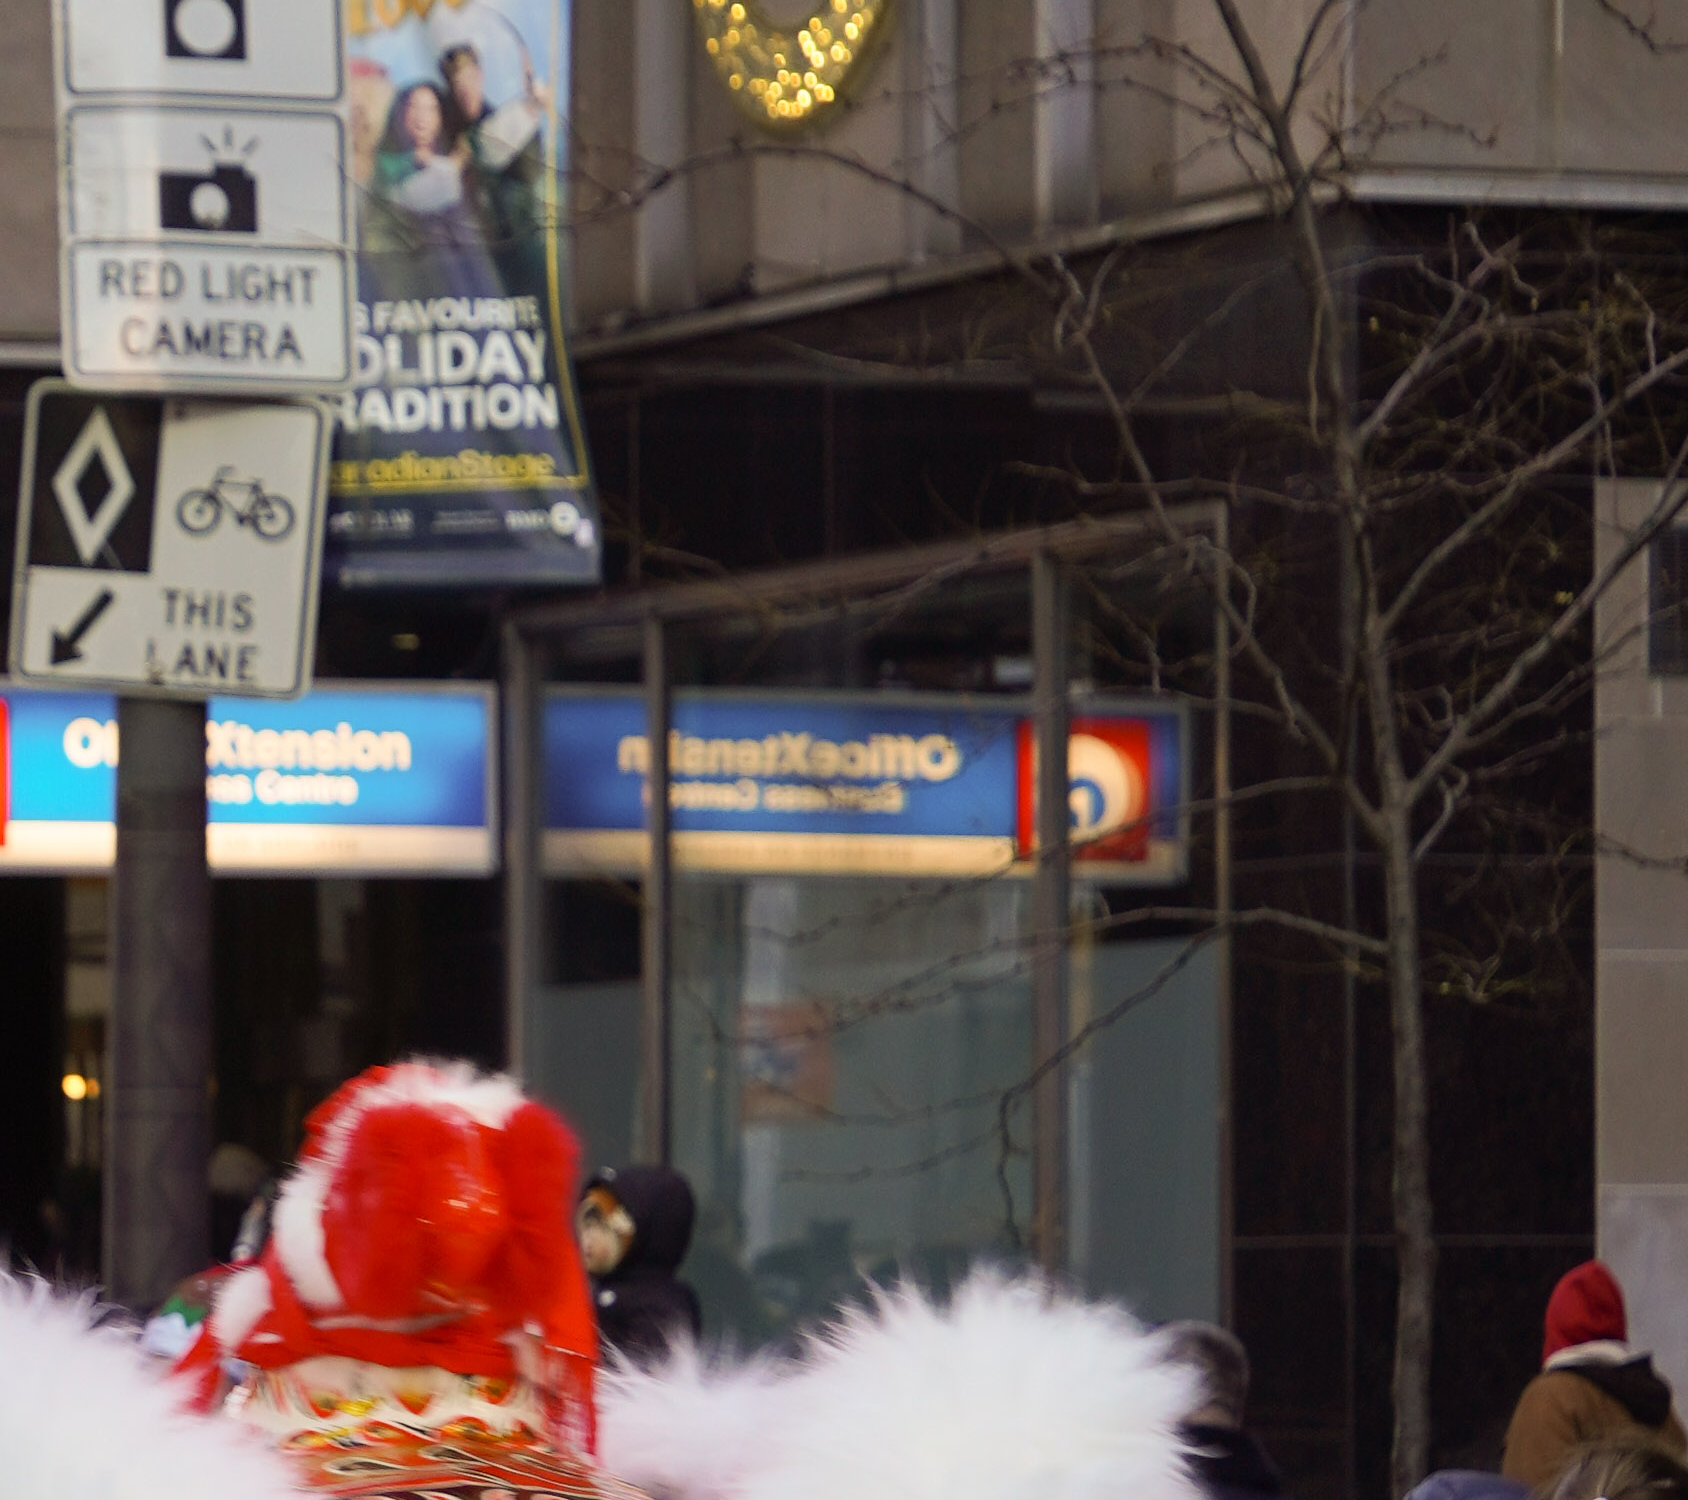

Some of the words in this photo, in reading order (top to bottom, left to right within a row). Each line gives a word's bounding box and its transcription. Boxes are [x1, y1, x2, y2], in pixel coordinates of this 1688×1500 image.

[99, 259, 185, 299] RED
[200, 262, 317, 304] LIGHT
[372, 296, 541, 333] FAVOURITE
[120, 317, 302, 362] CAMERA
[355, 329, 547, 386] OLIDAY
[338, 383, 559, 433] RADITION
[162, 586, 254, 631] THIS
[146, 637, 258, 683] LANE
